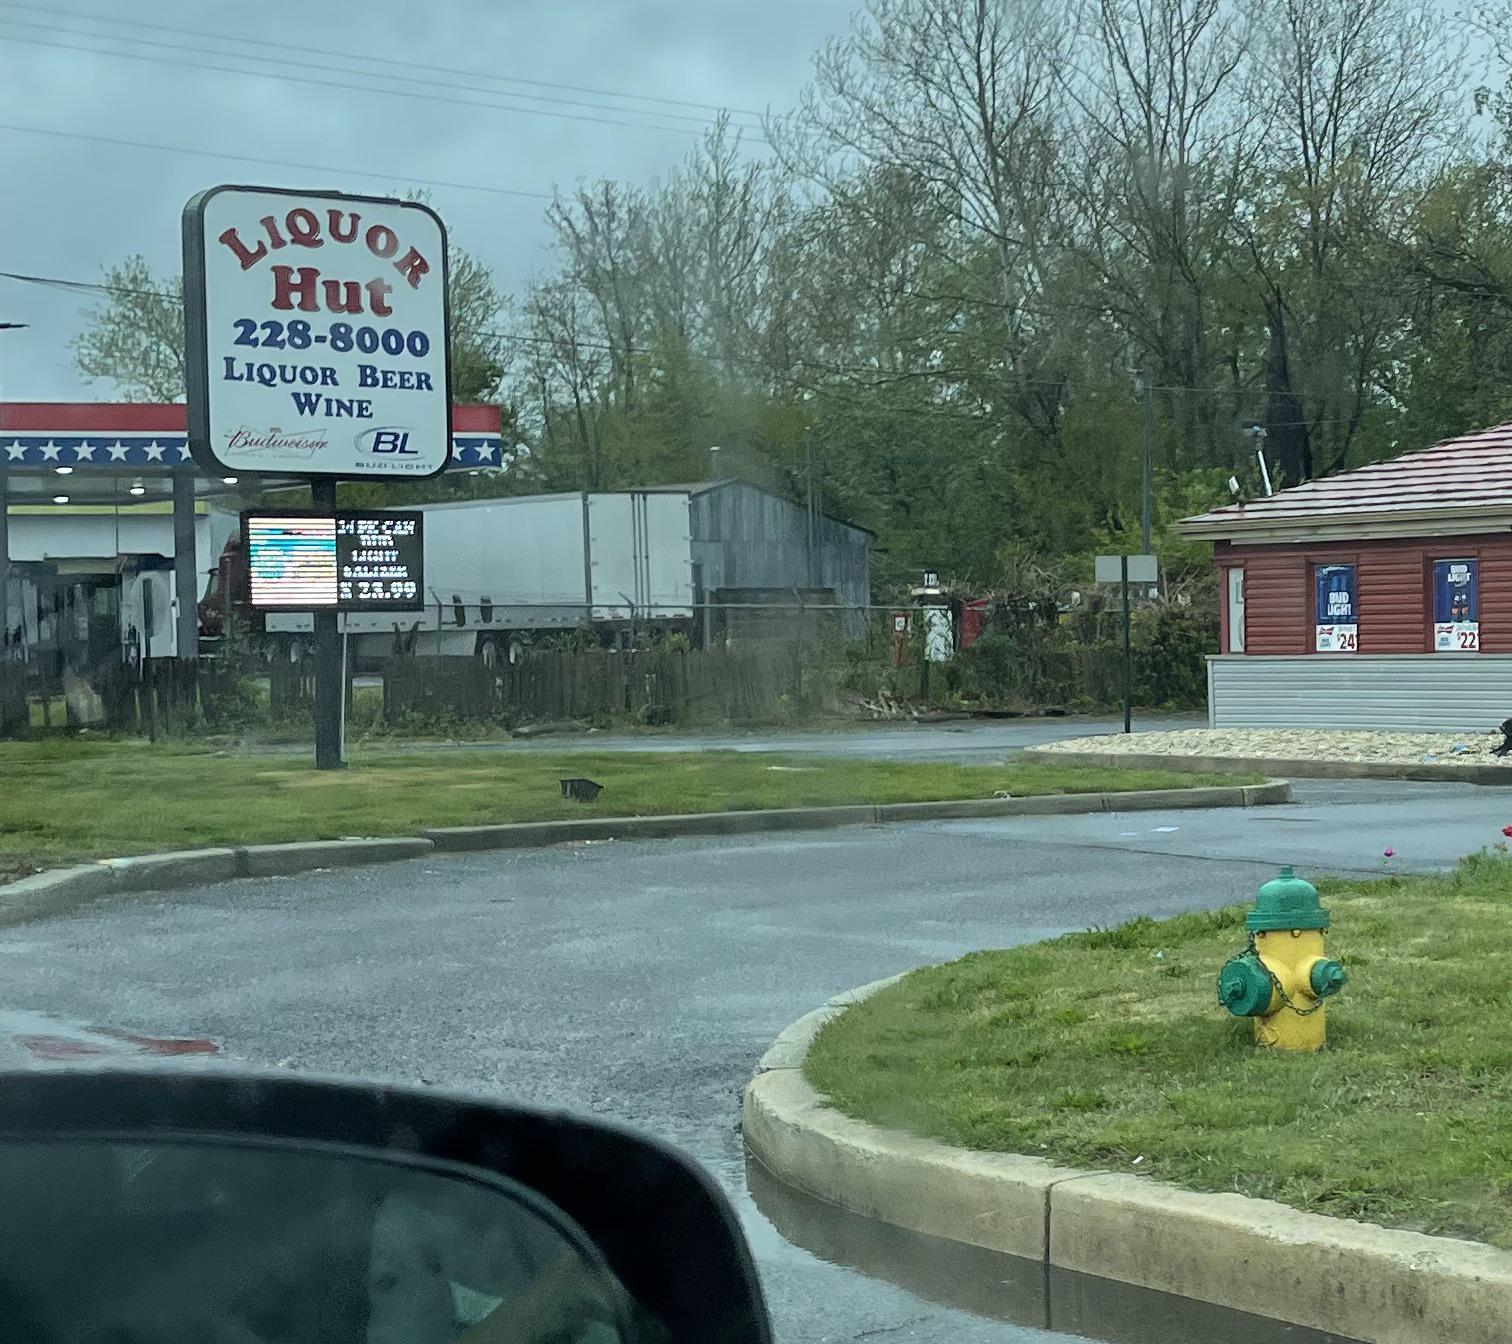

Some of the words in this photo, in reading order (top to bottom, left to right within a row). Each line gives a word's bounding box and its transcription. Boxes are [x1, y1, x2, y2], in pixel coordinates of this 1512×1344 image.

[218, 208, 431, 289] LIQUOR
[270, 265, 393, 317] Hut
[232, 318, 430, 357] 228-8000
[223, 357, 340, 388] LIQUOR
[358, 364, 434, 392] BEER
[291, 392, 374, 419] WINE
[227, 430, 329, 449] Budweiser
[372, 431, 419, 454] BL
[1327, 604, 1352, 616] LIGHT
[1329, 592, 1350, 604] BUD
